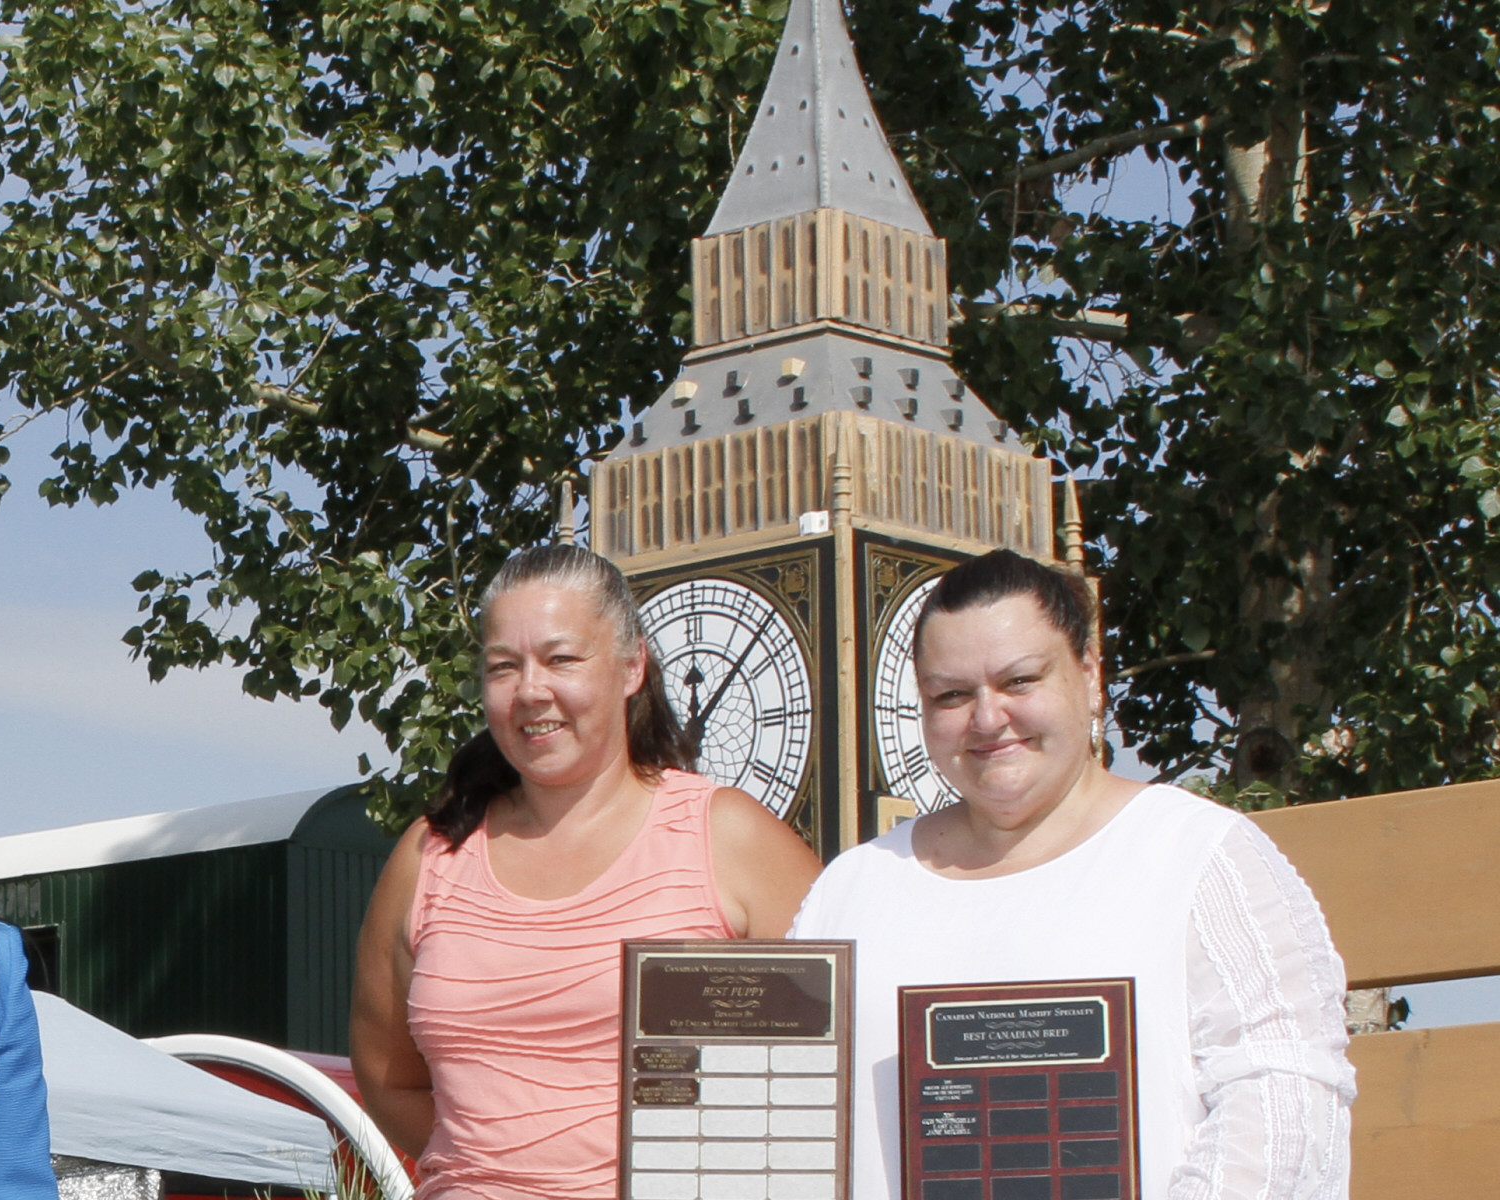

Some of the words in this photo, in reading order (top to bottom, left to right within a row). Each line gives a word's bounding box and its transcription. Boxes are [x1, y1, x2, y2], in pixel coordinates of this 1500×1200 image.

[702, 986, 728, 997] BEST
[730, 986, 765, 997] PUPPY
[963, 1031, 986, 1041] BEST
[988, 1030, 1040, 1041] CANADIAN
[1043, 1028, 1069, 1038] BRED
